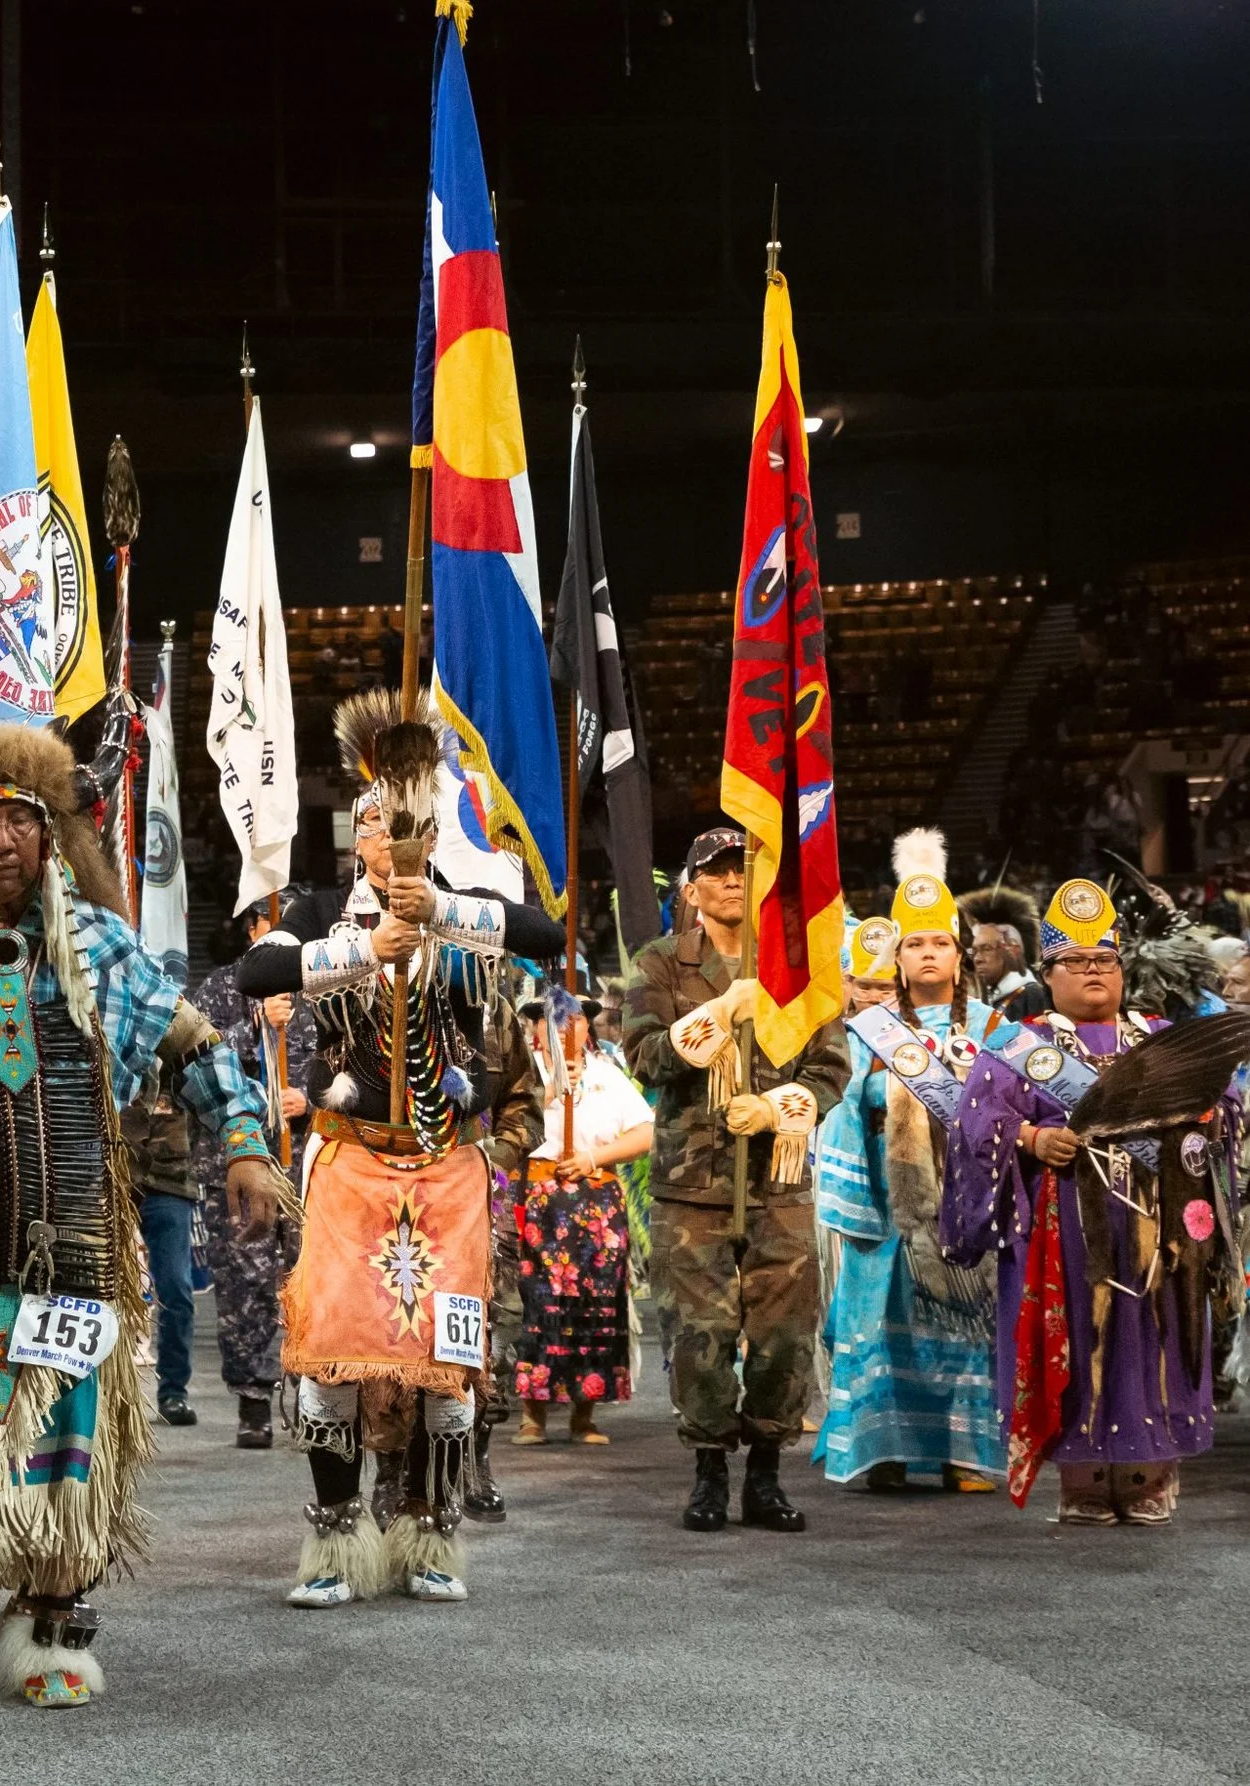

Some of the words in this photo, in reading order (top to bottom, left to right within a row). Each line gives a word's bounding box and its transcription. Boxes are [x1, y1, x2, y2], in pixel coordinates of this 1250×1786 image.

[18, 495, 31, 517] OF
[55, 548, 76, 616] TRIBE
[1075, 928, 1098, 943] UTE
[47, 1295, 101, 1315] SCFD
[449, 1296, 480, 1313] SCFD
[32, 1311, 102, 1356] 153
[446, 1312, 481, 1347] 617
[16, 1345, 40, 1358] Denver
[41, 1349, 62, 1361] March
[64, 1354, 78, 1367] Pow
